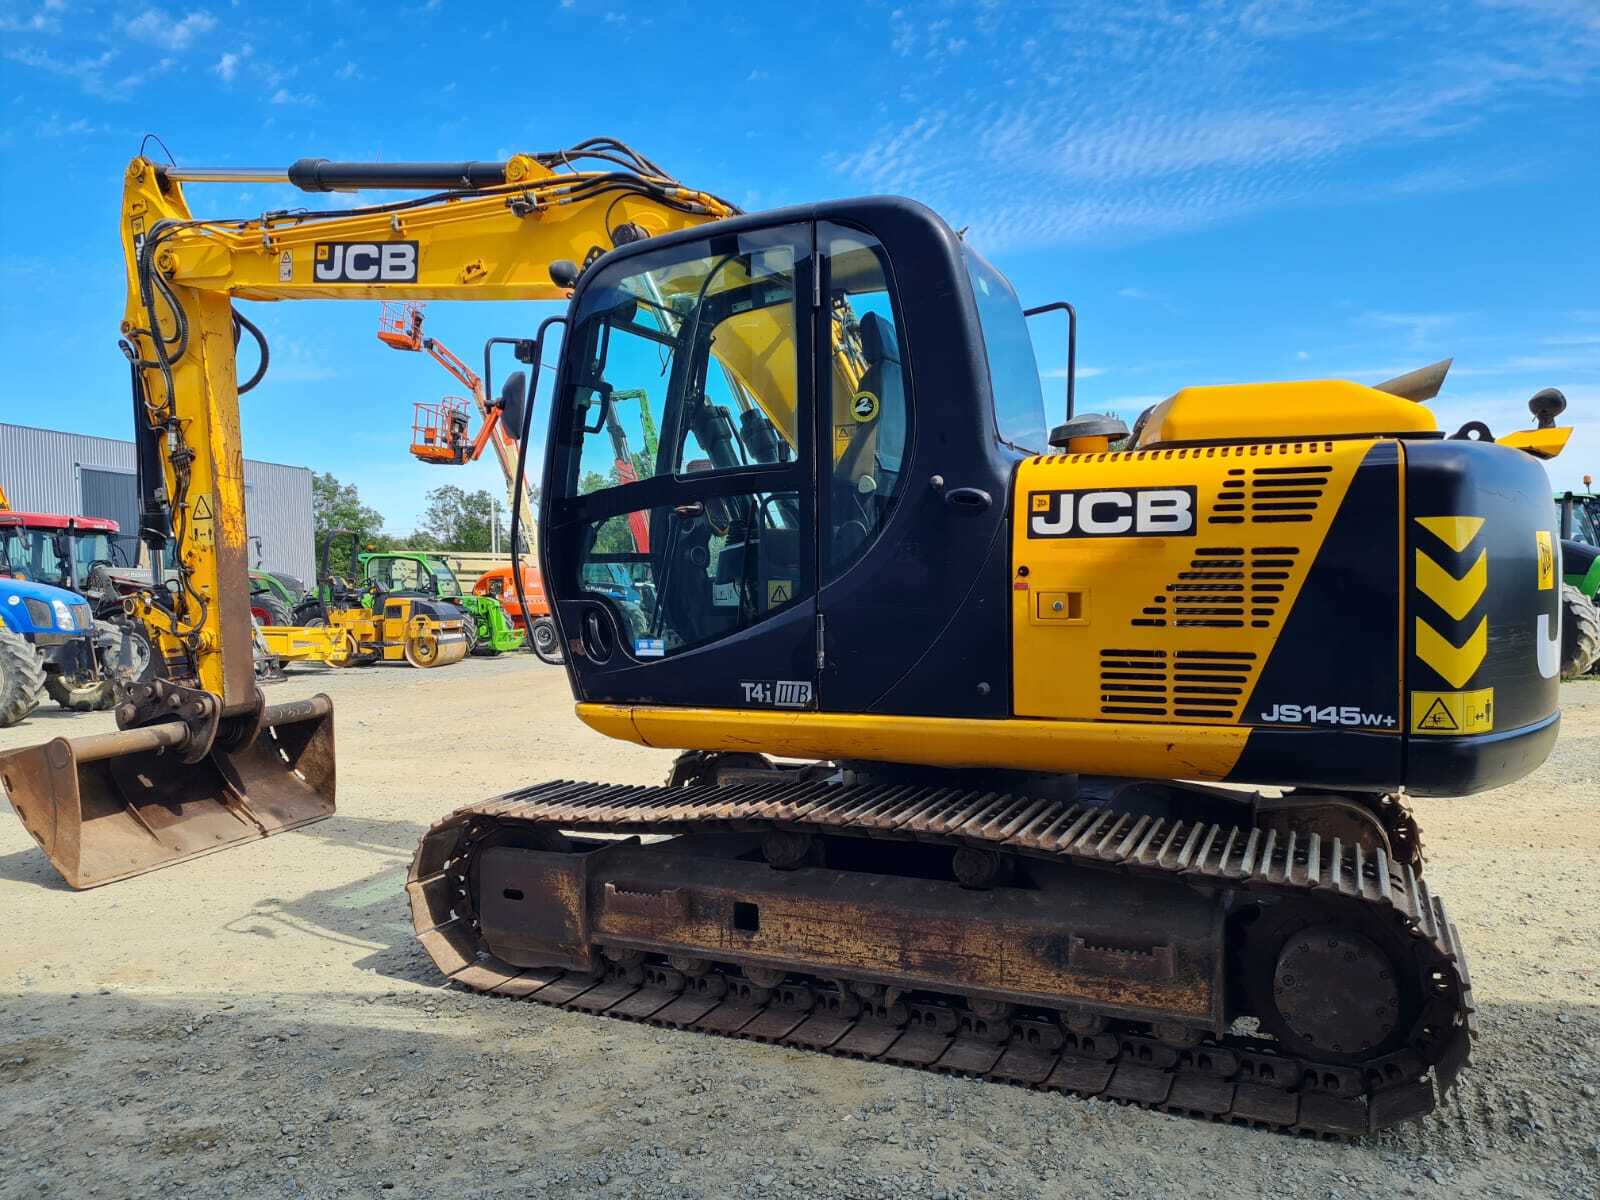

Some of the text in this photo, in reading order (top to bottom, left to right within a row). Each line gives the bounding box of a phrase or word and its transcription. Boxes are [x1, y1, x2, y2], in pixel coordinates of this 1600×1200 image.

[316, 244, 416, 280] JCB
[1031, 490, 1192, 535] JCB
[741, 682, 773, 703] T4i
